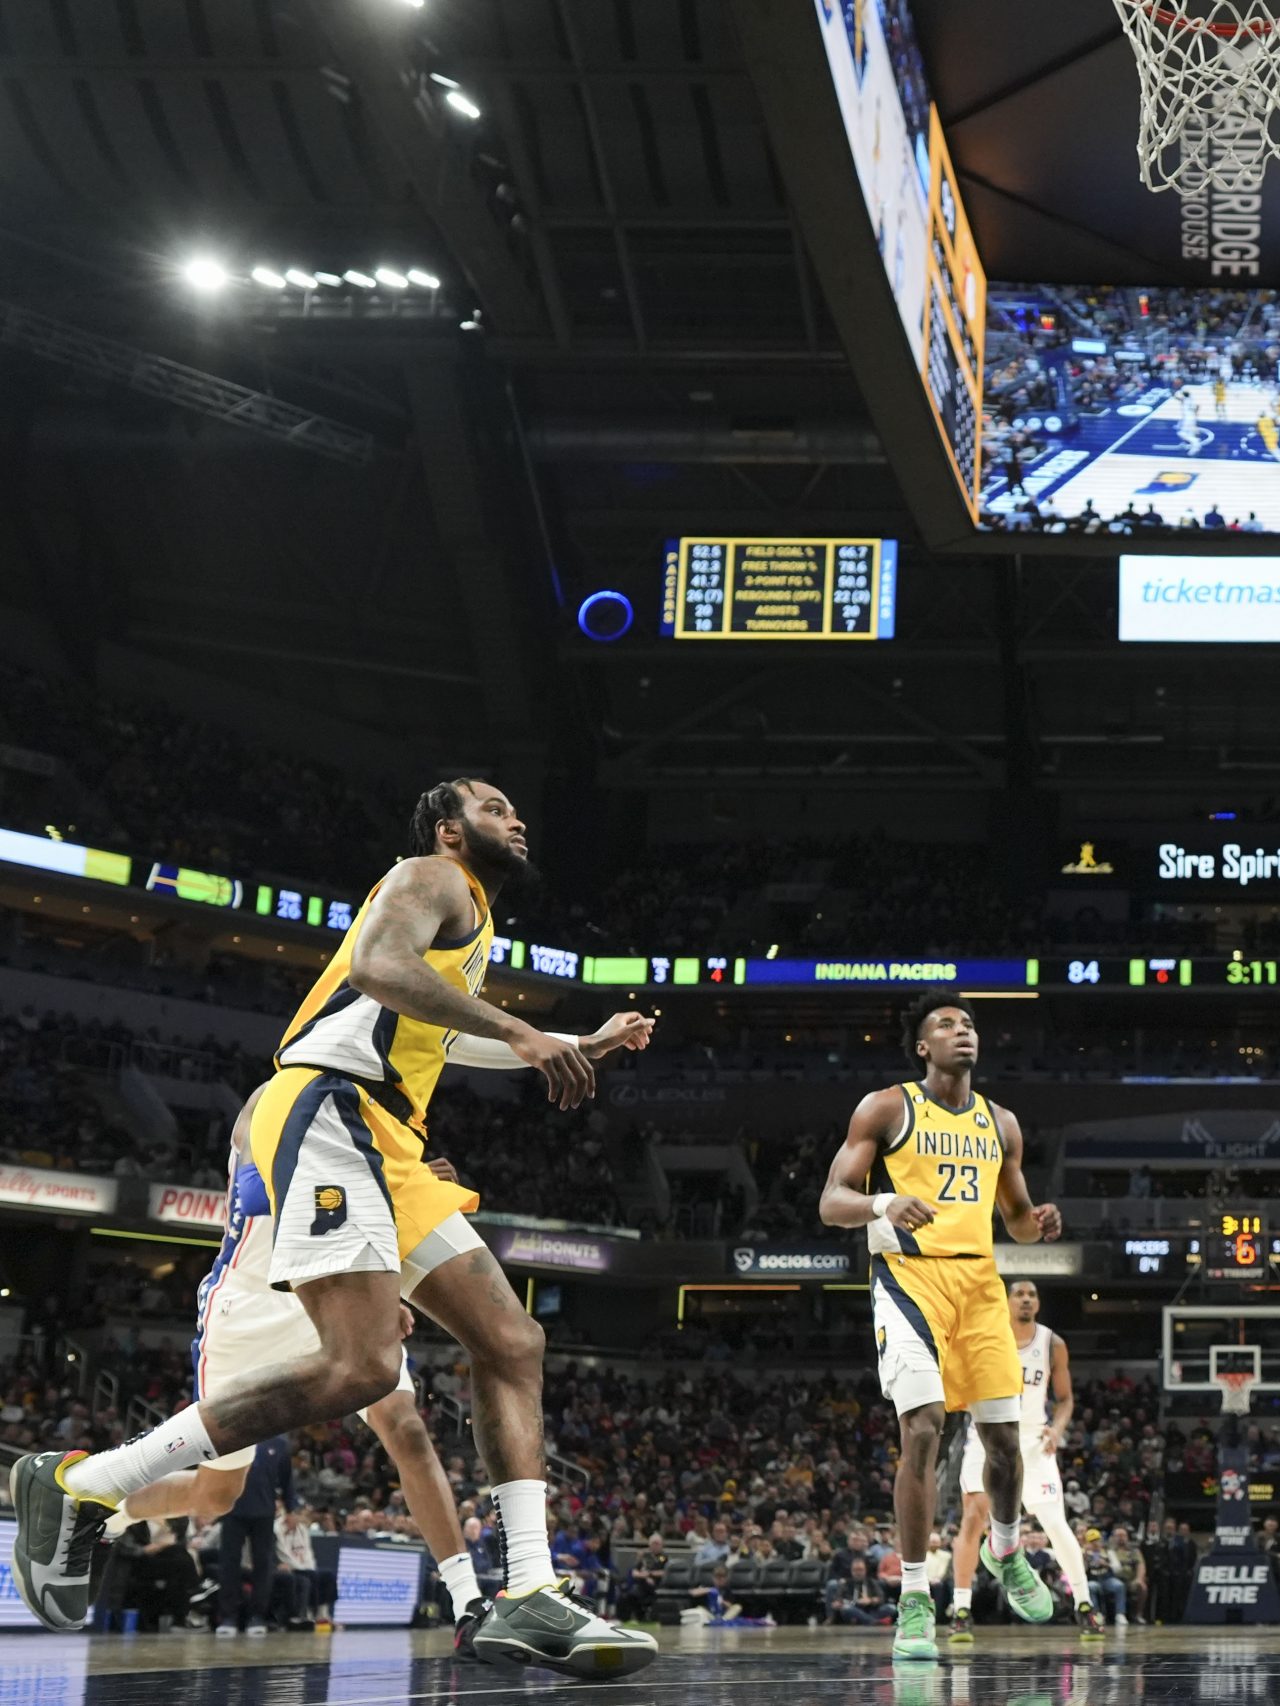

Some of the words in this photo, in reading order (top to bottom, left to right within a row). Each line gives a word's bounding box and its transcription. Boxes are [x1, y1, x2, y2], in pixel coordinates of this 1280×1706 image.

[838, 546, 868, 559] 66.7
[838, 560, 867, 574] 78.6
[690, 574, 720, 587] 41.7
[686, 589, 703, 603] 26
[834, 590, 851, 604] 22
[695, 604, 713, 617] 20
[842, 605, 860, 618] 20
[845, 619, 856, 632] 7
[1159, 844, 1214, 879] Sire
[277, 900, 302, 920] 26
[327, 911, 352, 931] 20
[532, 953, 577, 978] 10/24
[815, 963, 886, 980] INDIANA
[889, 963, 957, 980] PACERS
[1068, 960, 1100, 984] 84
[1226, 961, 1276, 985] 3:11
[654, 966, 667, 983] 3
[710, 969, 723, 983] 4
[916, 1131, 999, 1161] INDIANA
[938, 1164, 980, 1203] 23
[1223, 1216, 1260, 1236] 3:11
[543, 1239, 600, 1260] DONUTS
[1125, 1240, 1170, 1255] PACERS
[1236, 1233, 1256, 1265] 6
[759, 1253, 850, 1269] socios.com
[1216, 1526, 1250, 1536] BELLE
[1220, 1536, 1246, 1546] TIRE
[1198, 1565, 1269, 1584] BELLE
[1206, 1585, 1260, 1604] TIRE
